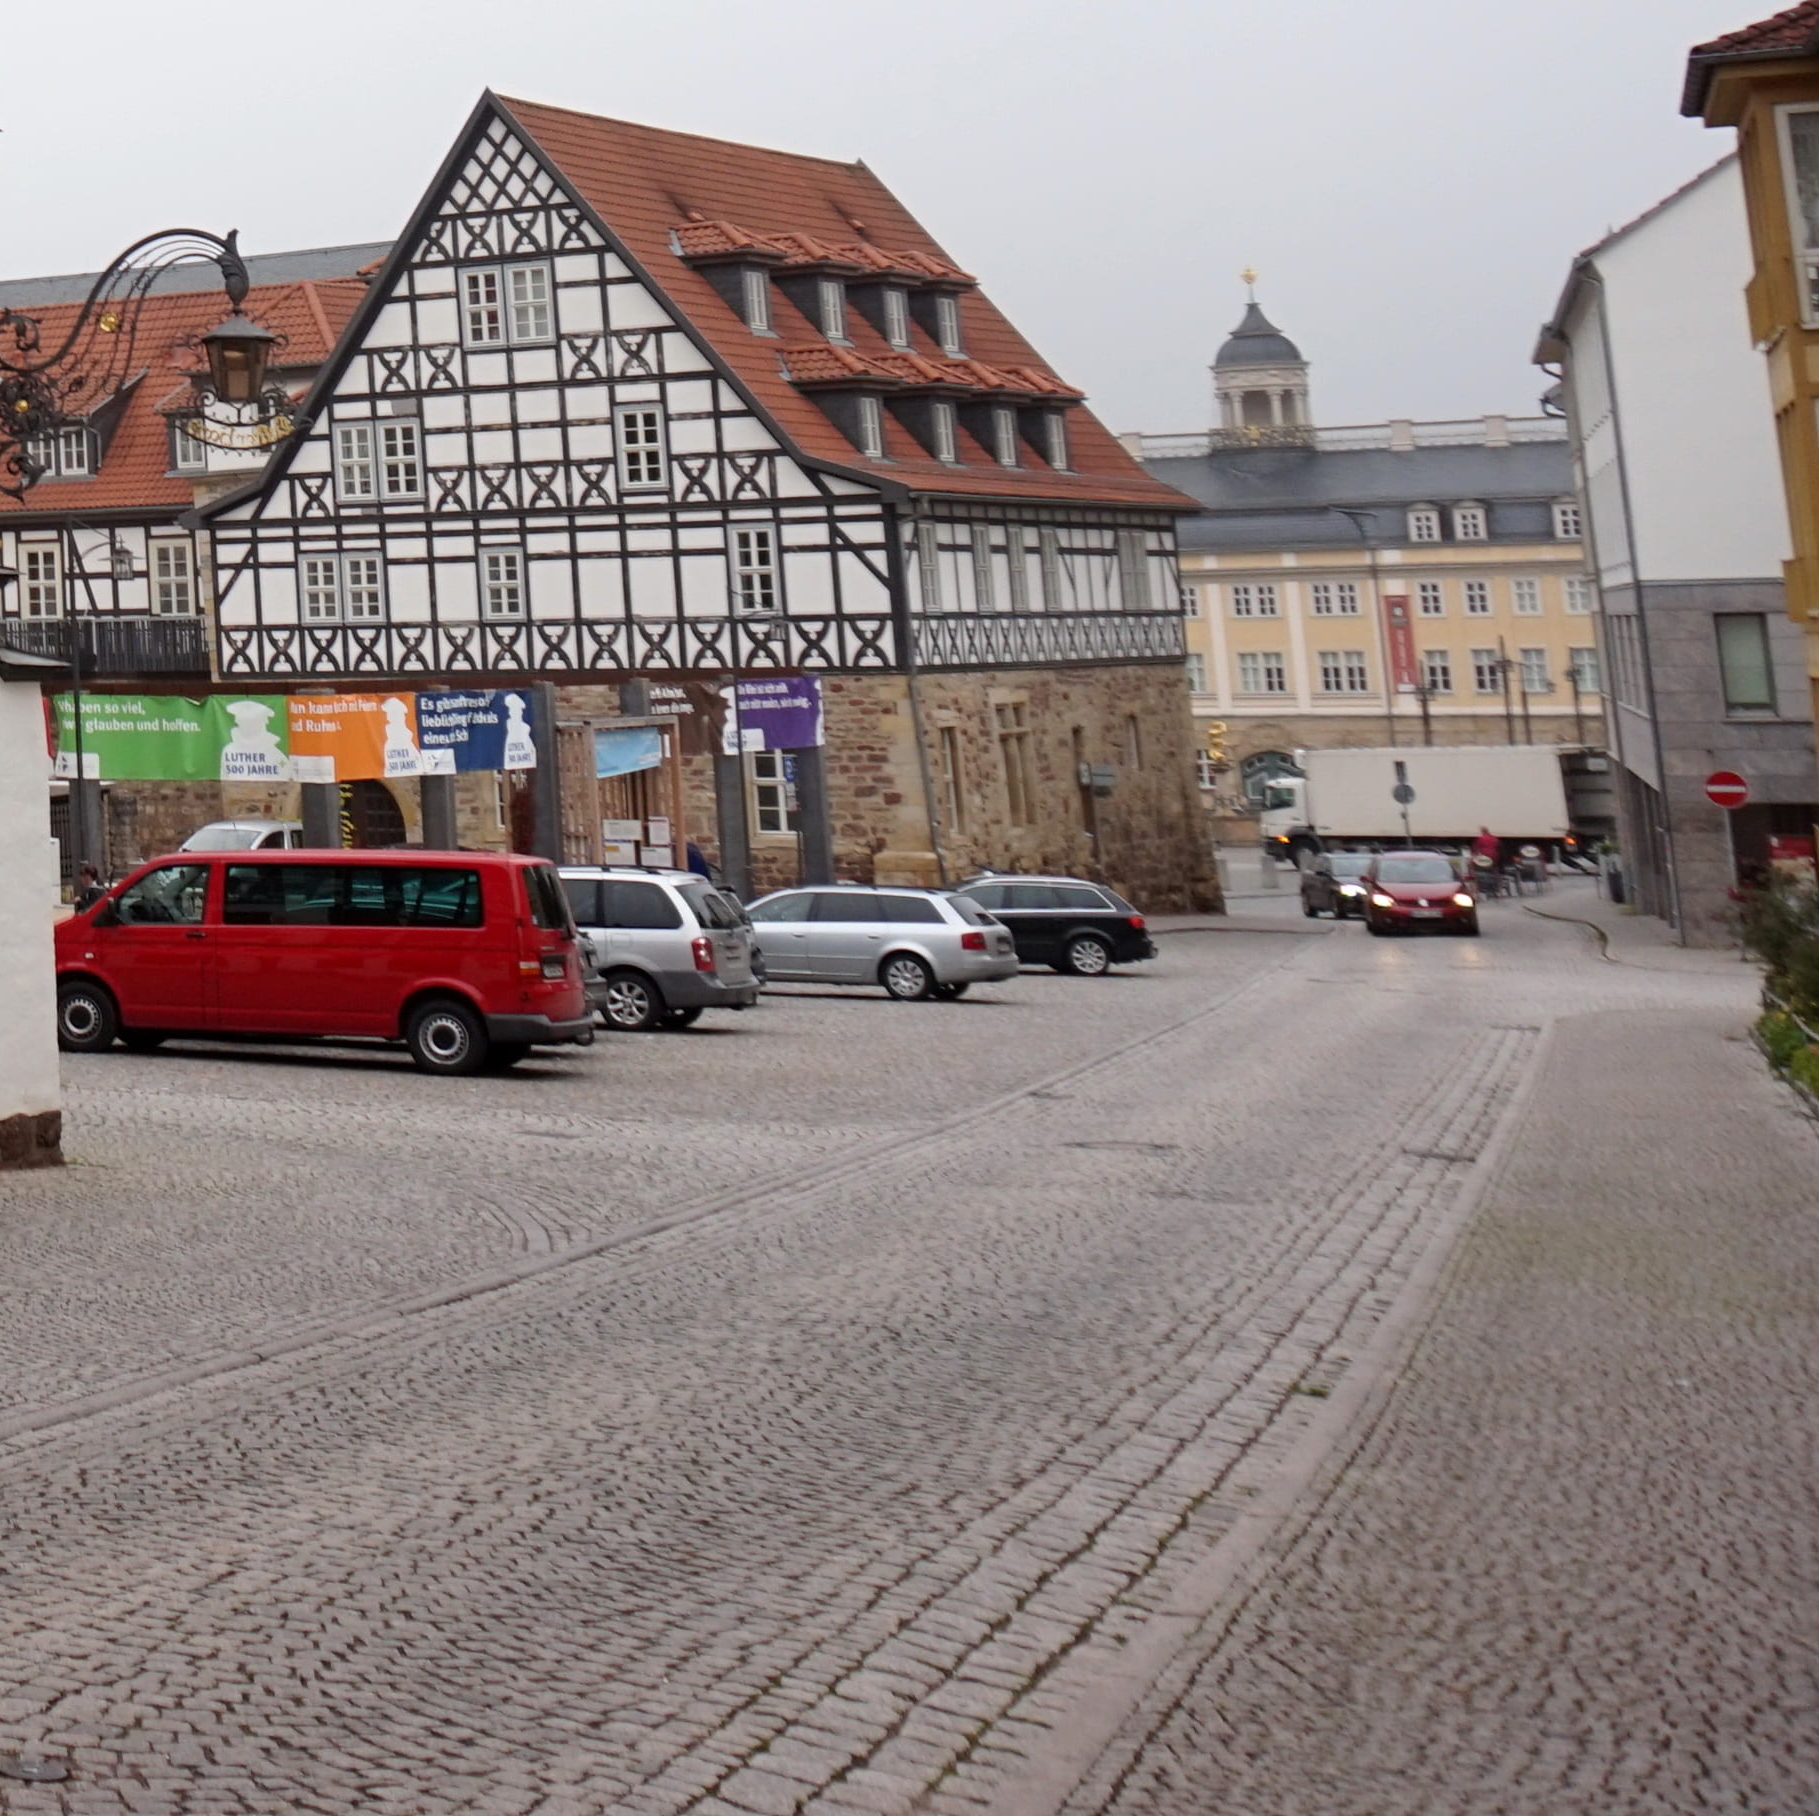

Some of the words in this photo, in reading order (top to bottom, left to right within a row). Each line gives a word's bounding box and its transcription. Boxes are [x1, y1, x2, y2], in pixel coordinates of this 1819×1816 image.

[104, 703, 119, 714] so
[121, 700, 146, 715] viel,
[420, 696, 434, 711] Es
[85, 717, 134, 734] glauben
[137, 718, 160, 731] und
[162, 717, 201, 732] hoffen.
[224, 752, 266, 763] LUTHER
[226, 764, 244, 774] 500
[247, 764, 280, 776] JAHRE
